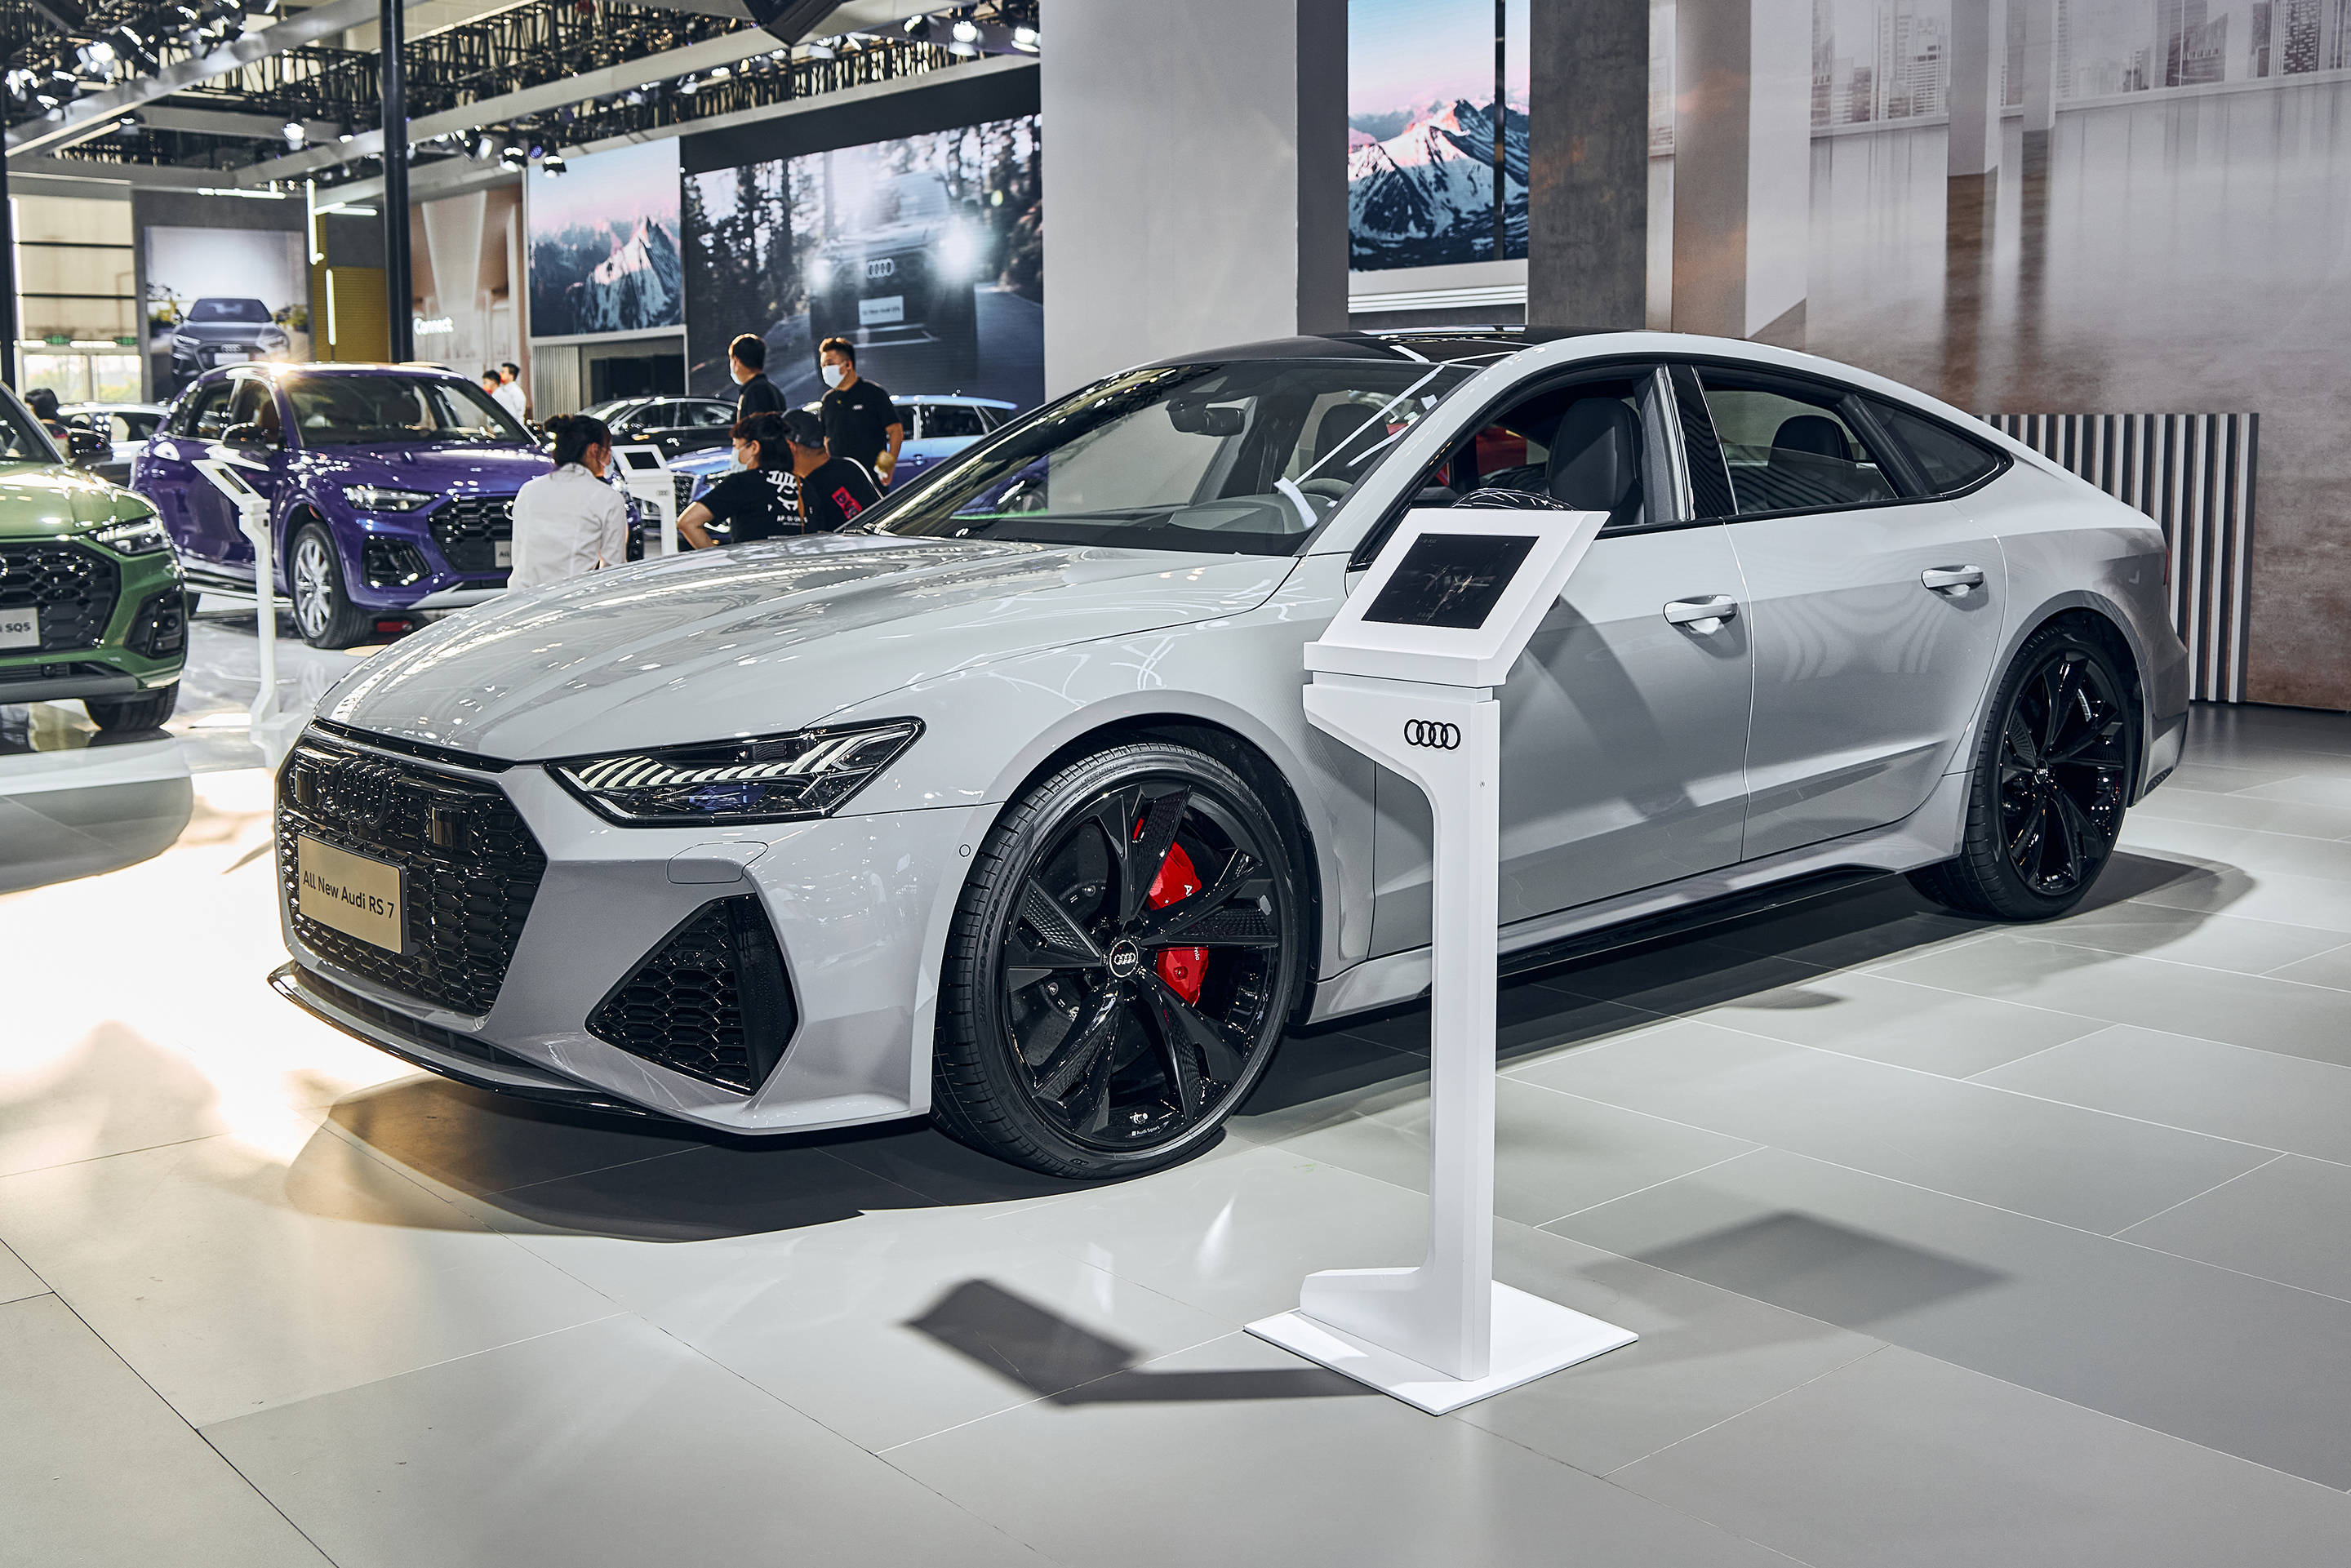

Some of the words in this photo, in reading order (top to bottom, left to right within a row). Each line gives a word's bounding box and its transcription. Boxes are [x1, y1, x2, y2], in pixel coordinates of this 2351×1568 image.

[5, 621, 31, 633] SQ5
[303, 870, 316, 890] All
[318, 877, 339, 899] New
[341, 886, 366, 909] Audi
[369, 895, 384, 916] RS
[387, 902, 394, 919] 7
